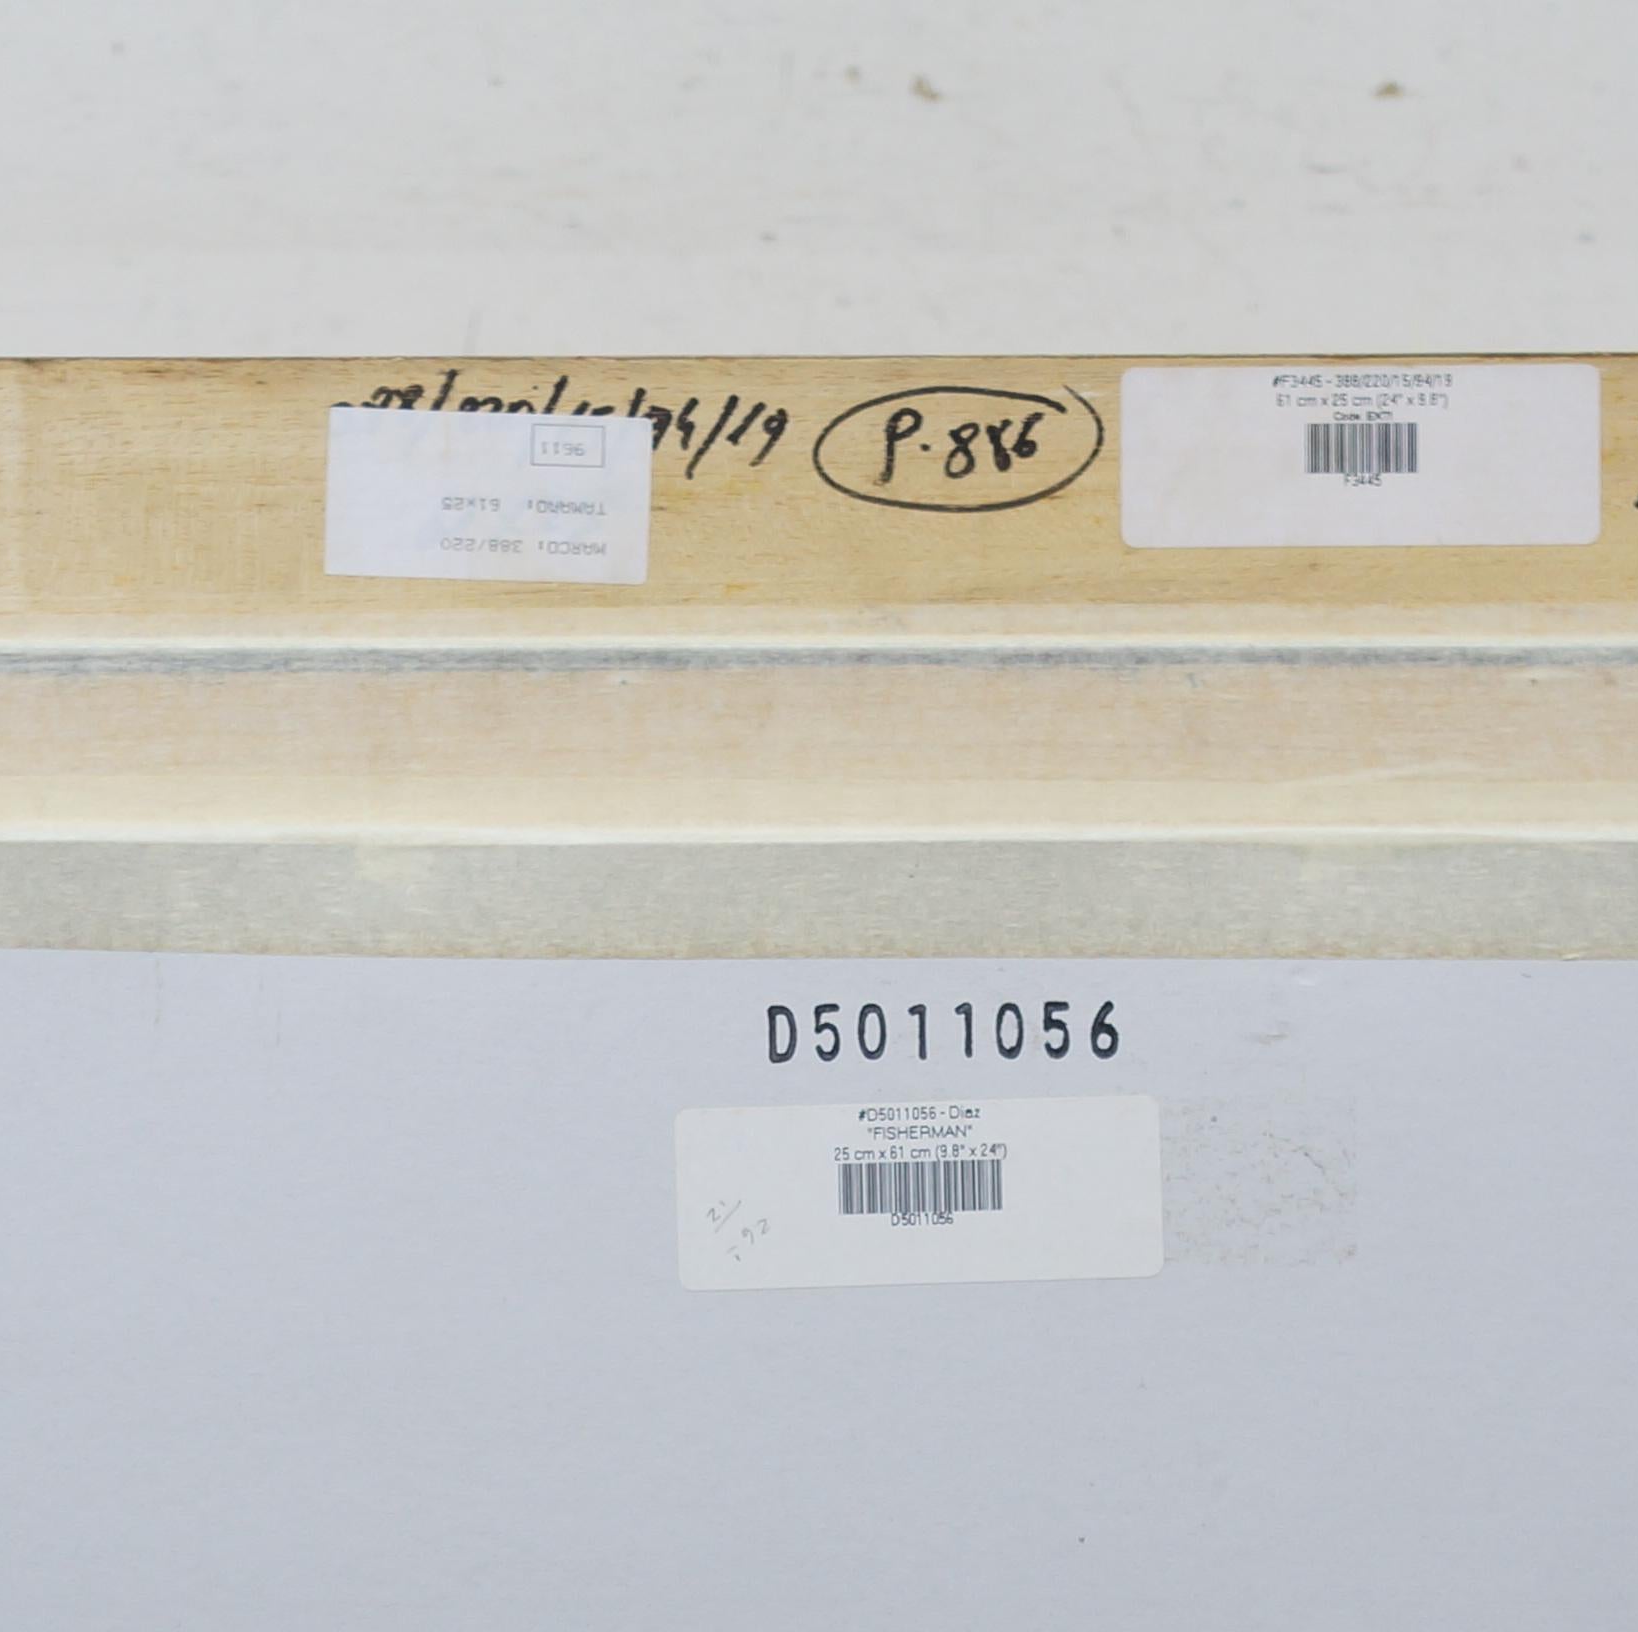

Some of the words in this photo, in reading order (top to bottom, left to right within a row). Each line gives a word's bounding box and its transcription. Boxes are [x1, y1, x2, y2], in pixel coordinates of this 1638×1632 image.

[1296, 396, 1318, 407] cm
[540, 441, 586, 457] 9611
[440, 537, 524, 554] 388/220
[537, 540, 607, 556] MARCO:
[766, 1001, 1120, 1064] D5011056
[858, 1106, 936, 1122] #D5011056
[867, 1125, 973, 1140] "FISHERMAN"
[834, 1147, 850, 1161] 25
[854, 1150, 875, 1161] cm
[890, 1145, 905, 1159] 61
[910, 1148, 931, 1159] cm
[891, 1212, 954, 1227] D5011056
